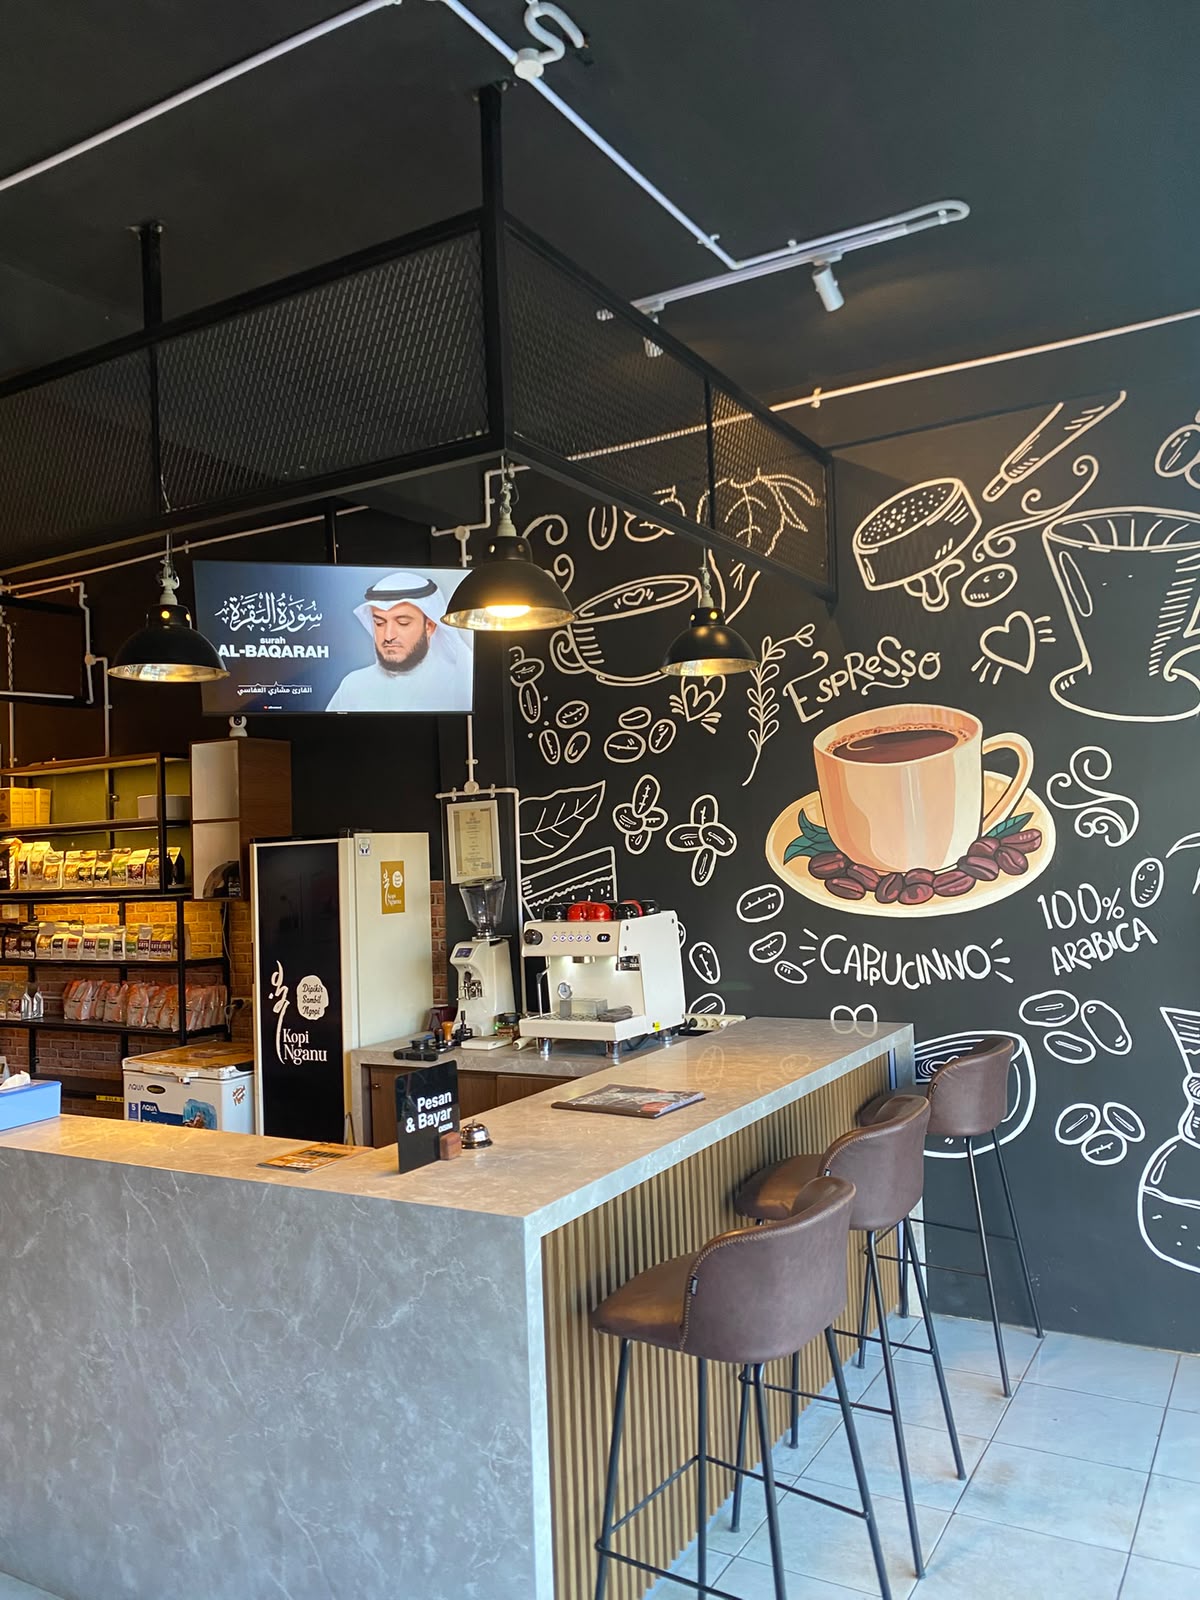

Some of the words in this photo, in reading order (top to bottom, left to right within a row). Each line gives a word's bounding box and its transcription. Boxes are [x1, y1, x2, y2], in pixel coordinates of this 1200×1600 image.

[260, 636, 286, 645] surah
[218, 645, 329, 659] AL-BAQARAH
[1037, 882, 1125, 930] 100%
[282, 1028, 310, 1047] Kopi
[284, 1044, 328, 1065] Nganu
[417, 1091, 452, 1113] Pesan
[405, 1117, 416, 1134] &
[418, 1107, 453, 1130] Bayar
